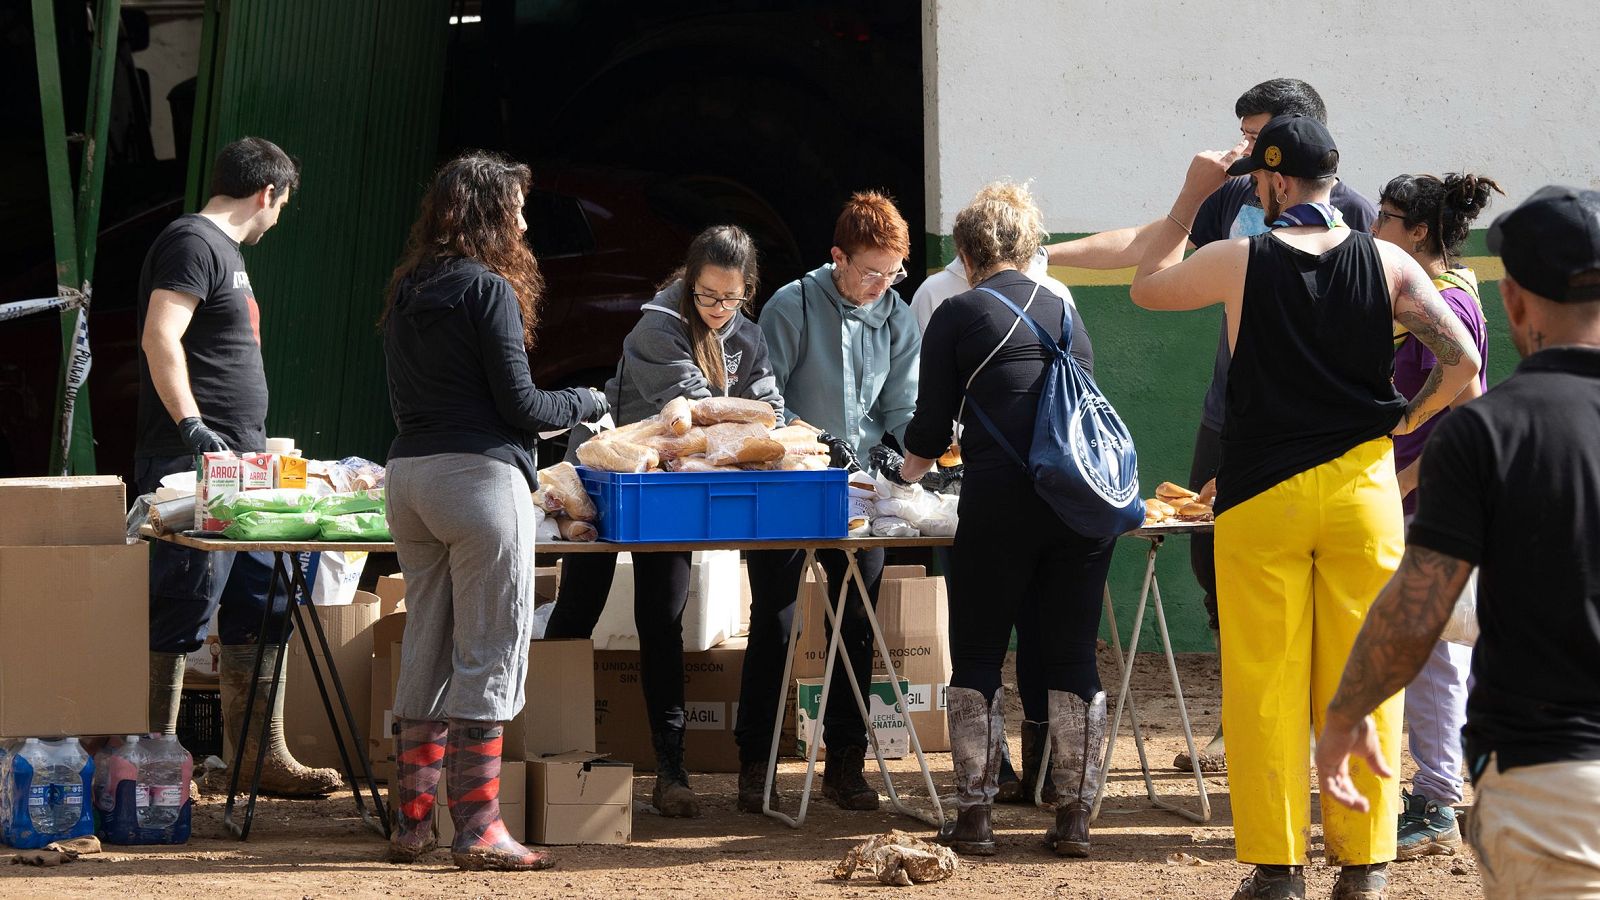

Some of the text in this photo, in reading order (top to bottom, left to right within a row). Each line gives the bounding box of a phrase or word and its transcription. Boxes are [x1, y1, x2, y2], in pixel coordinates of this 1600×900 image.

[70, 349, 91, 384] POLICIA
[210, 466, 238, 479] ARROZ
[249, 472, 267, 480] ARROZ
[299, 551, 310, 580] RIN
[805, 651, 816, 659] 10
[890, 646, 931, 658] ROSCÓN
[602, 662, 640, 671] UNIDAD
[685, 661, 723, 672] OSCÓN
[620, 674, 638, 683] SIN
[907, 693, 925, 705] GIL
[683, 707, 719, 722] RÁGIL
[872, 720, 907, 730] SNATADA
